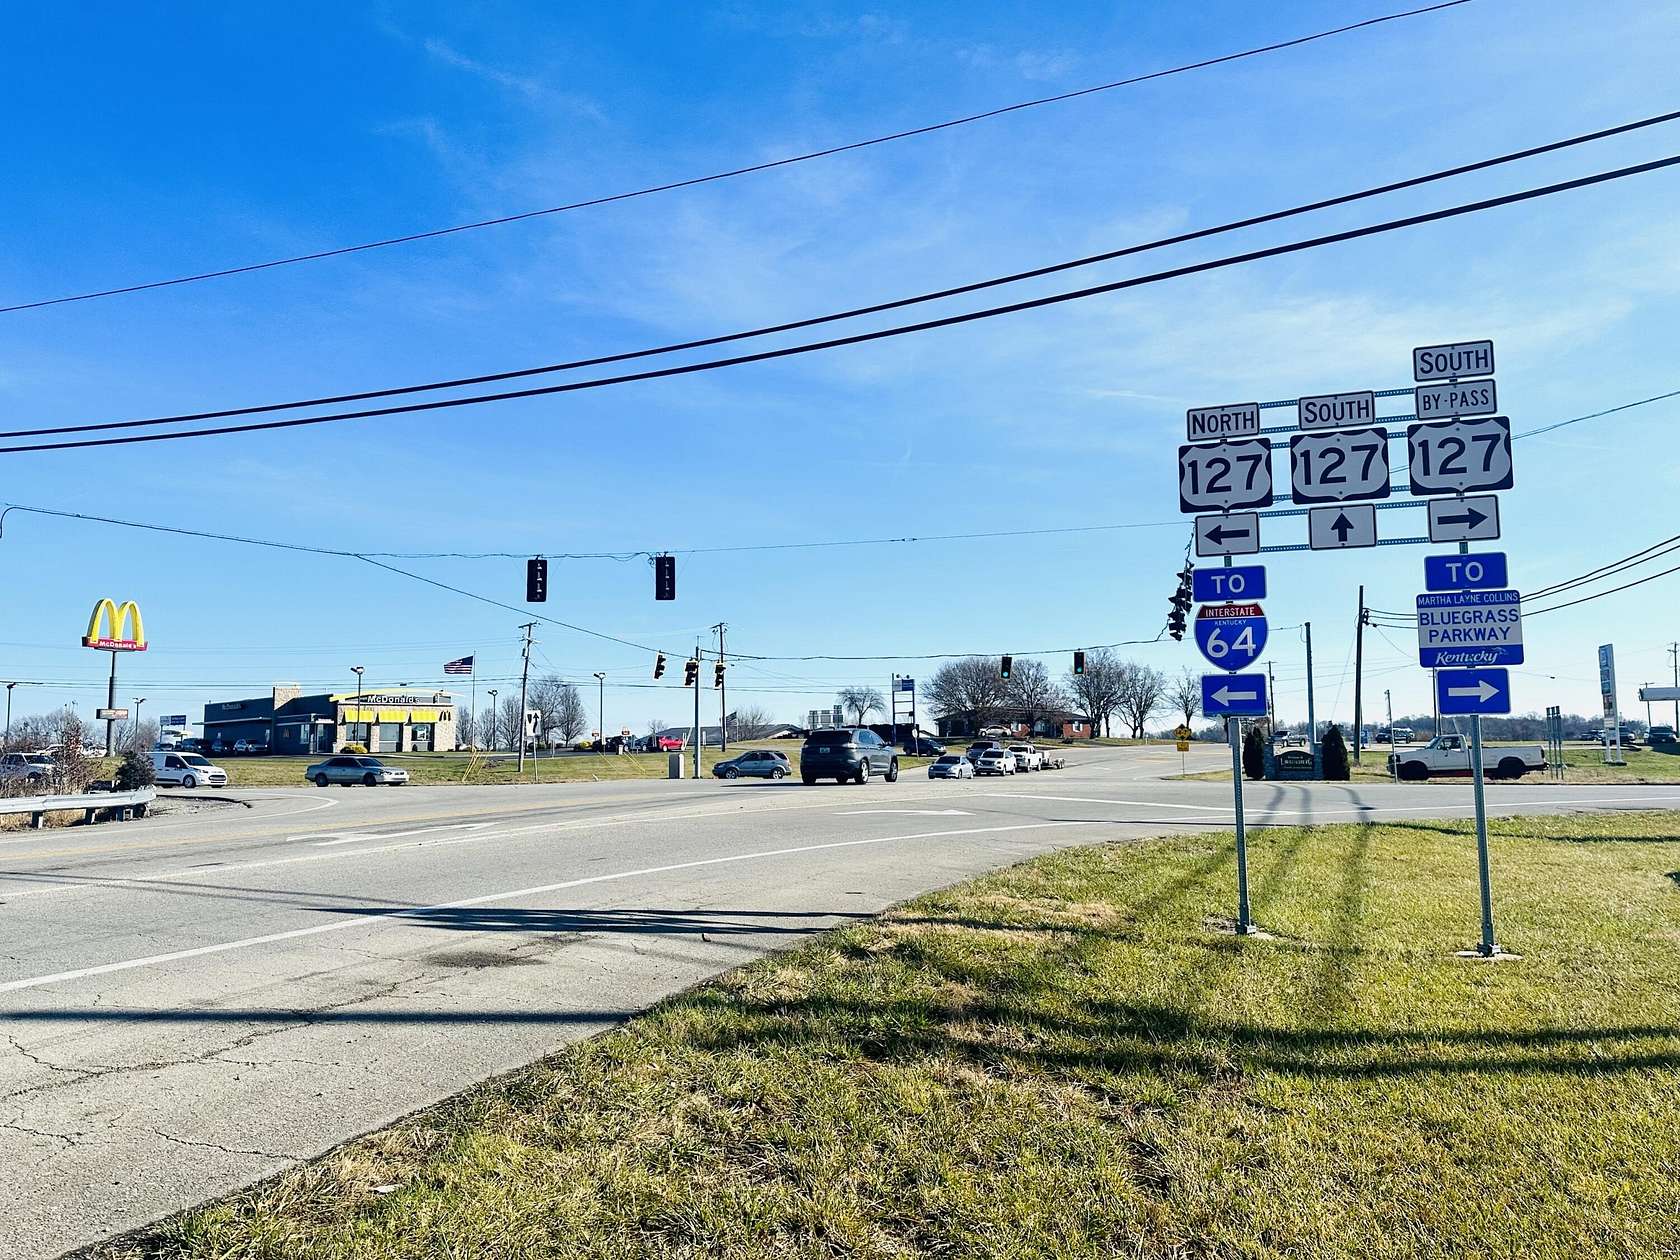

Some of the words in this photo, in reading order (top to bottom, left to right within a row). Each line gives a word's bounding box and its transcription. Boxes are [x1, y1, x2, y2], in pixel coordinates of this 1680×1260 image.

[1420, 348, 1489, 374] SOUTH
[1423, 388, 1489, 411] BY-PASS
[1191, 410, 1255, 435] NORTH
[1304, 399, 1370, 424] SOUTH
[1299, 443, 1379, 486] 127
[1417, 433, 1501, 477] 127
[1187, 454, 1262, 495] 127
[1445, 561, 1484, 583] TO
[1210, 574, 1245, 594] TO
[1418, 596, 1452, 606] MARTHA
[1454, 594, 1480, 604] LAYNE
[1483, 592, 1518, 602] COLLINS
[1205, 606, 1255, 617] INTERSTATE
[1420, 608, 1519, 626] BLUEGRASS
[1206, 626, 1257, 658] 64
[1429, 626, 1511, 643] PARKWAY
[1435, 650, 1498, 665] Kentucky
